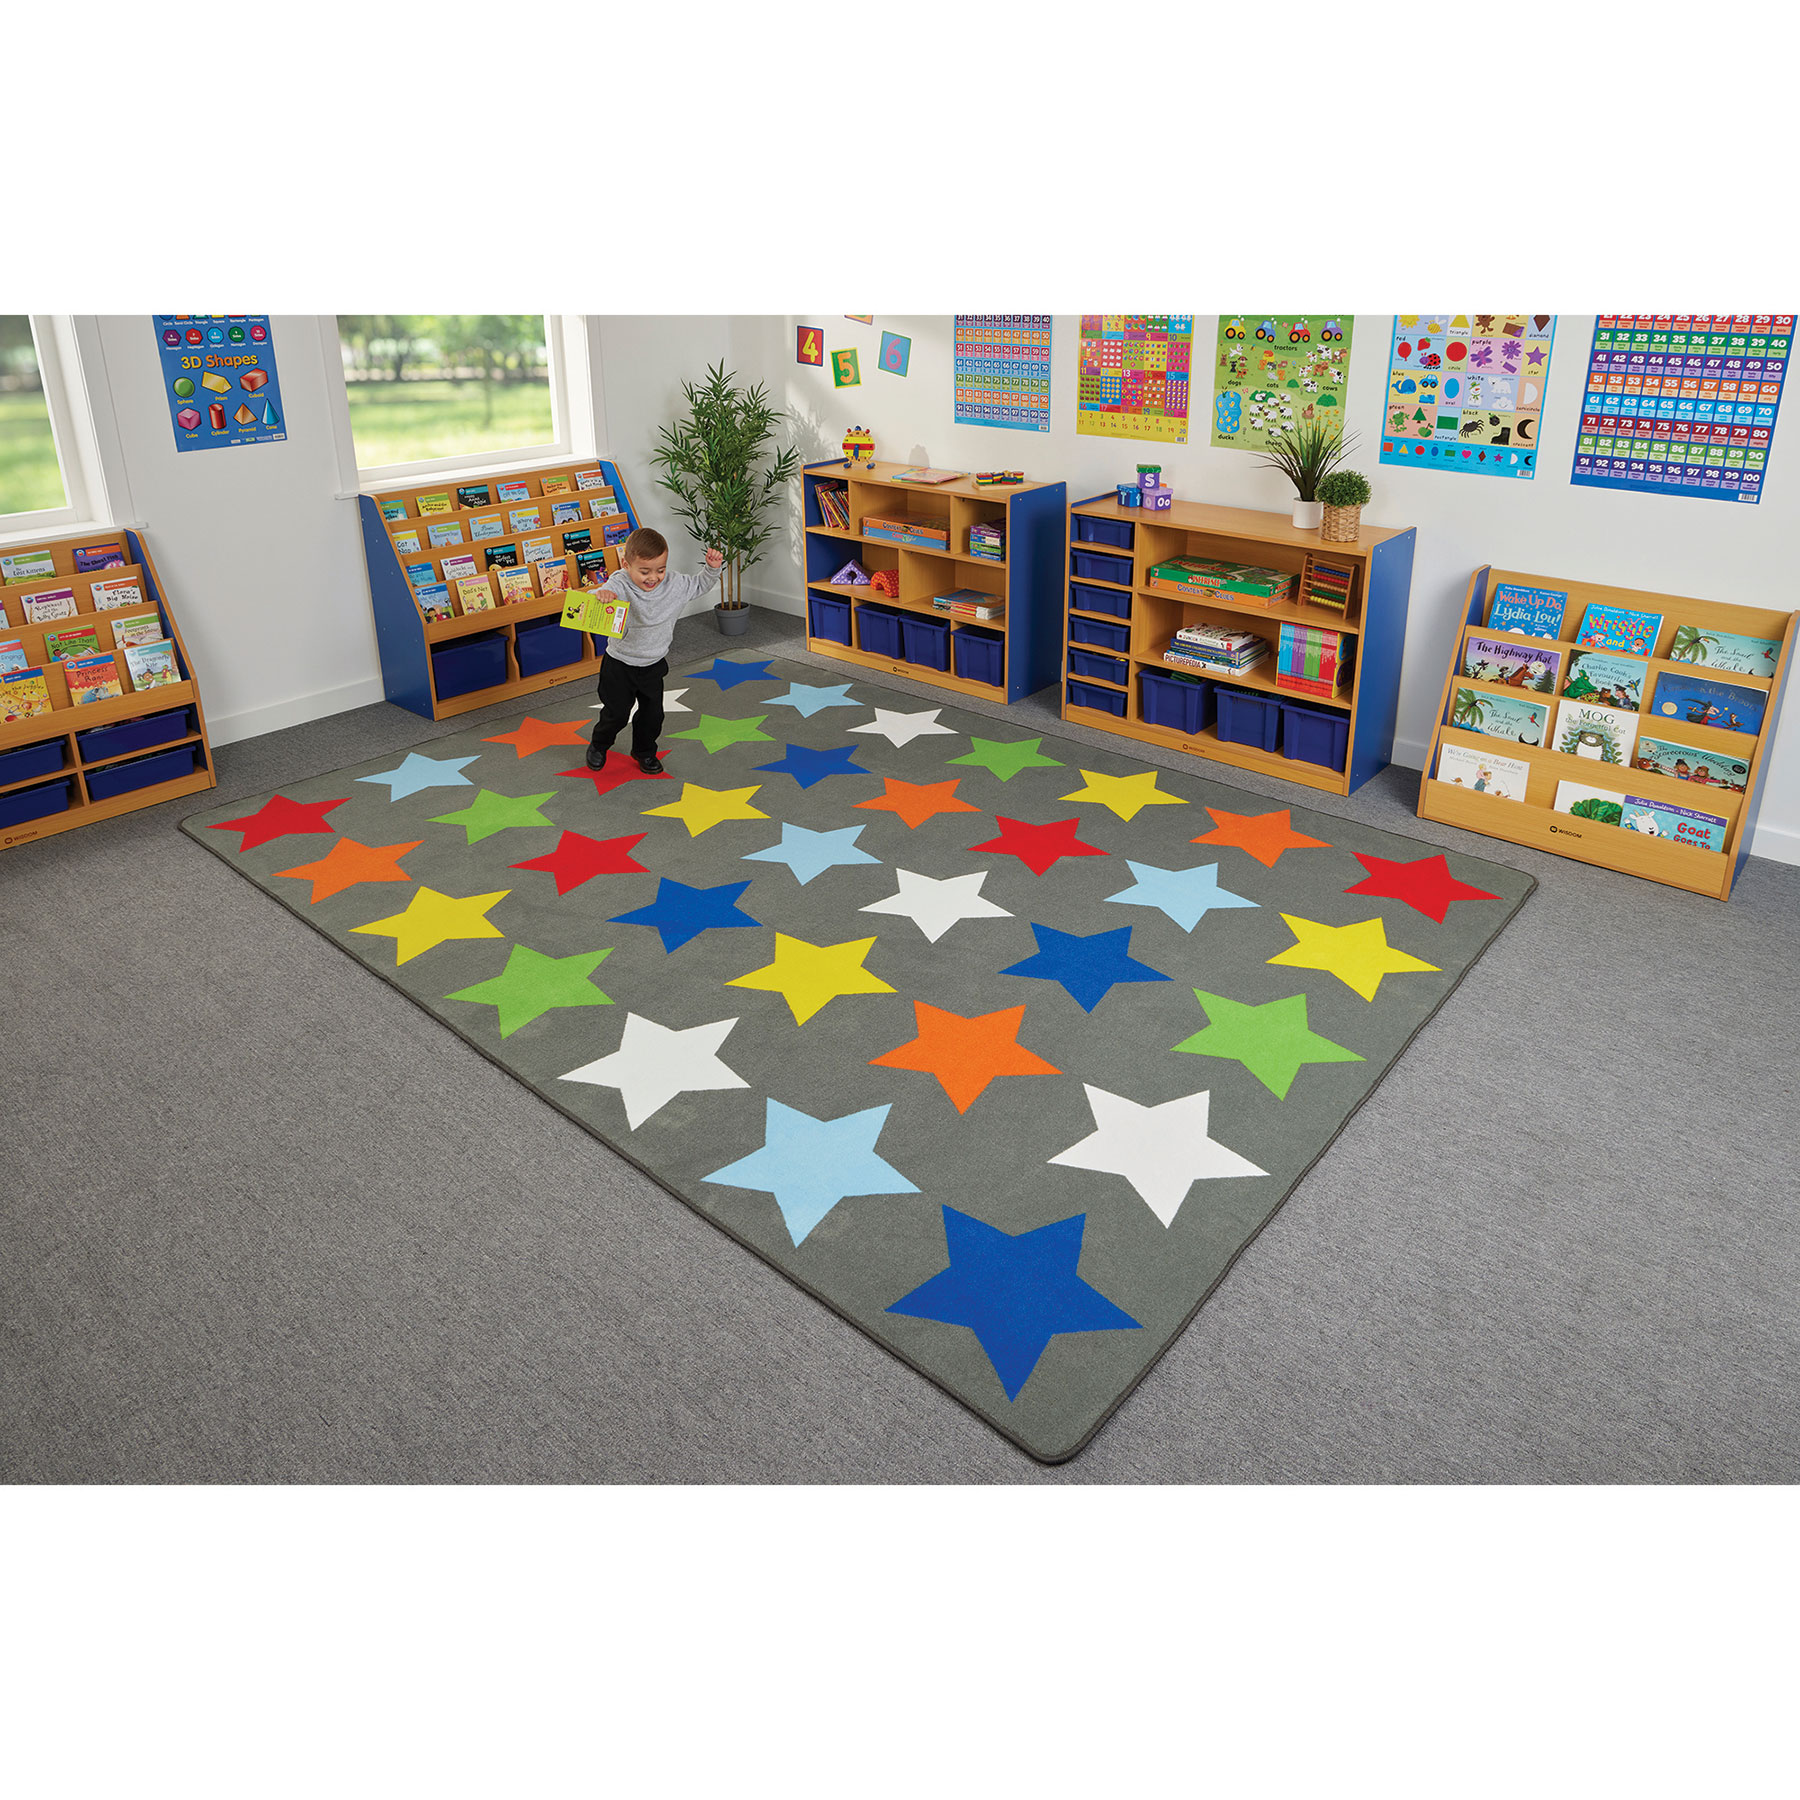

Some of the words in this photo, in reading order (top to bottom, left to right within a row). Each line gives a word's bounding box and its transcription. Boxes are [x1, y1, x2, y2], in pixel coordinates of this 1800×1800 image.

[1776, 316, 1790, 324] 30
[802, 331, 818, 362] 4
[1600, 332, 1610, 340] 31
[1672, 336, 1686, 344] 35
[1770, 340, 1786, 348] 40
[886, 338, 902, 370] 6
[181, 356, 202, 369] 3D
[205, 354, 258, 369] Shapes
[837, 352, 855, 384] 5
[1612, 354, 1626, 362] 42
[1686, 358, 1702, 366] 46
[1766, 362, 1782, 370] 50
[1762, 384, 1778, 394] 60
[1678, 402, 1692, 410] 66
[1758, 408, 1772, 416] 70
[1658, 422, 1670, 430] 75
[1752, 430, 1768, 438] 80
[1690, 446, 1704, 454] 87
[1145, 473, 1155, 487] S
[1686, 468, 1700, 476] 97
[1742, 474, 1760, 482] 100
[1192, 575, 1221, 587] INFERENCE
[1177, 584, 1204, 595] CONTEXT
[1214, 590, 1235, 601] CLUES
[1499, 591, 1527, 604] Wake
[1529, 595, 1544, 609] Up
[1495, 604, 1531, 621] Lydia
[1534, 611, 1561, 626] Lou!
[1589, 613, 1654, 640] Wriggle
[51, 641, 62, 649] Not
[1606, 639, 1625, 647] and
[1477, 642, 1492, 653] The
[1494, 645, 1533, 663] Highway
[1535, 652, 1552, 664] Rat
[1164, 654, 1201, 668] PICTUREPEDIA
[76, 666, 108, 677] Princess
[1583, 664, 1610, 673] Charlie
[1709, 688, 1724, 696] the
[1503, 712, 1523, 724] Snail
[1580, 709, 1618, 726] MOG
[1488, 723, 1516, 736] Whale
[1580, 721, 1614, 733] Forgetful
[1634, 798, 1648, 806] Julia
[1649, 802, 1674, 812] Donaldson
[1694, 813, 1717, 823] Sharratt
[1559, 829, 1582, 838] WISDOM
[1677, 822, 1711, 839] Goat
[1673, 834, 1697, 847] Goes
[1699, 842, 1710, 850] To
